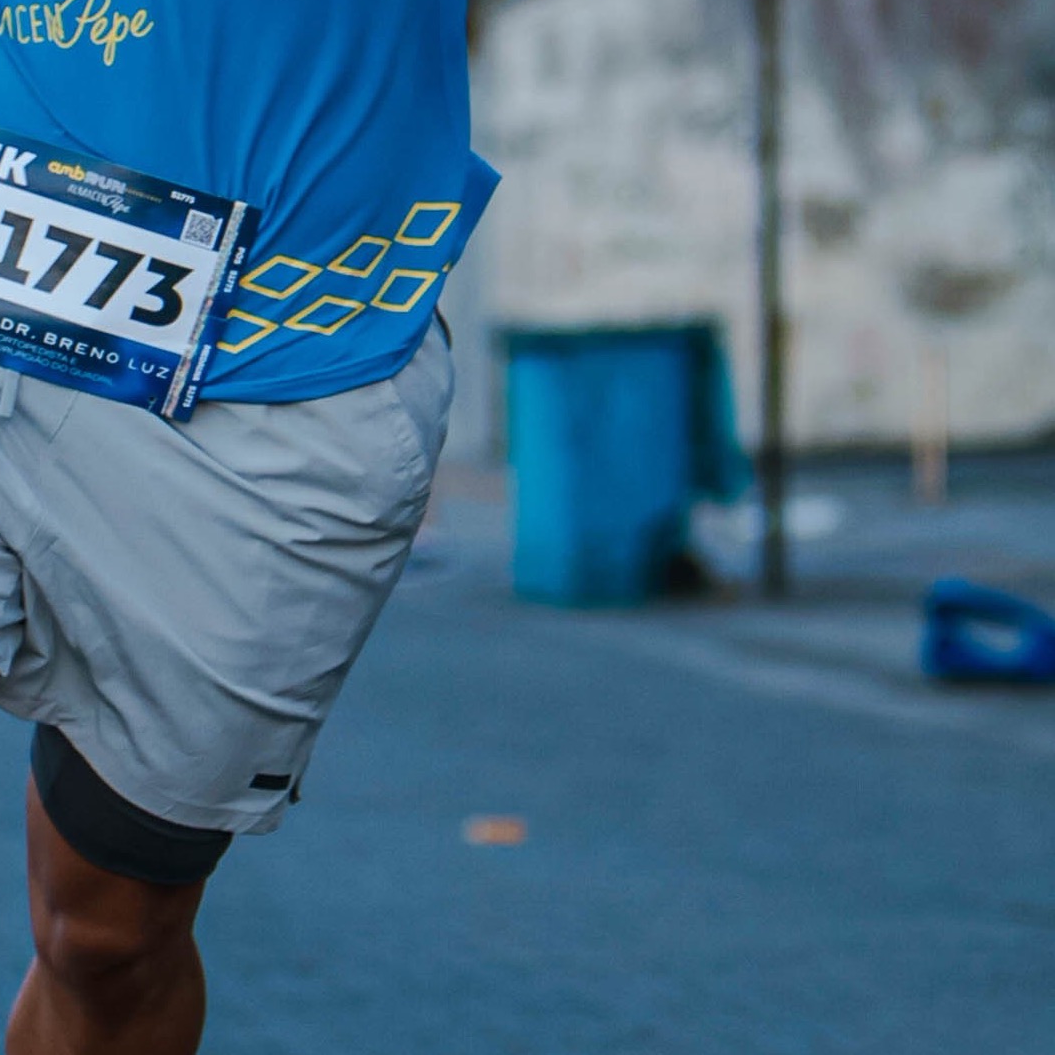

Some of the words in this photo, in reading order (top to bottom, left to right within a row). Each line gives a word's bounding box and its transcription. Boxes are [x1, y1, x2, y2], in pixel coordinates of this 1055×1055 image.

[0, 317, 36, 340] DR.
[42, 331, 120, 365] BRENO
[127, 357, 171, 380] LUZ
